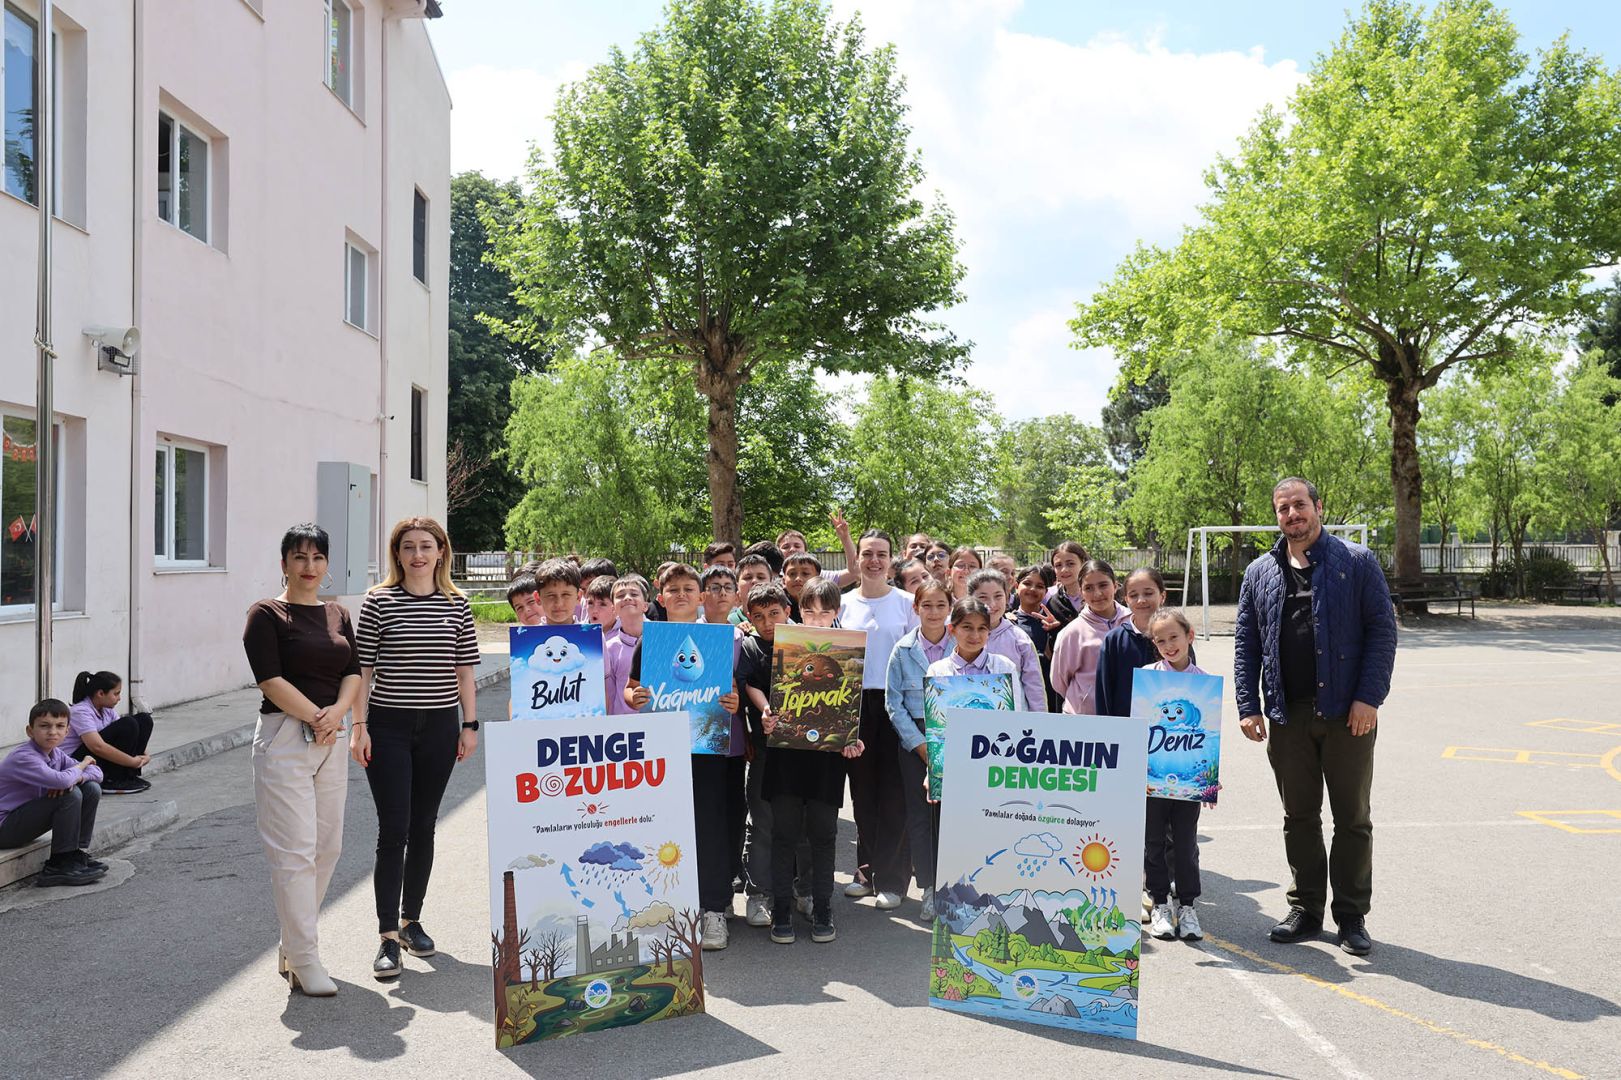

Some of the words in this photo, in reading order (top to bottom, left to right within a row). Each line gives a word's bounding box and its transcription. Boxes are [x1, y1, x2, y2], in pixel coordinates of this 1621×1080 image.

[531, 672, 586, 710] Bulut
[778, 679, 852, 717] Toprak
[537, 731, 645, 768] DENGE
[971, 729, 1119, 769] DOĞANIN
[1148, 725, 1206, 754] Deniz
[516, 757, 666, 803] BOZULDU
[988, 763, 1098, 792] DENGESİ
[574, 819, 603, 831] yolculuğu
[604, 817, 638, 827] engellerle
[1015, 812, 1036, 822] doğada
[1038, 815, 1065, 825] özgürce
